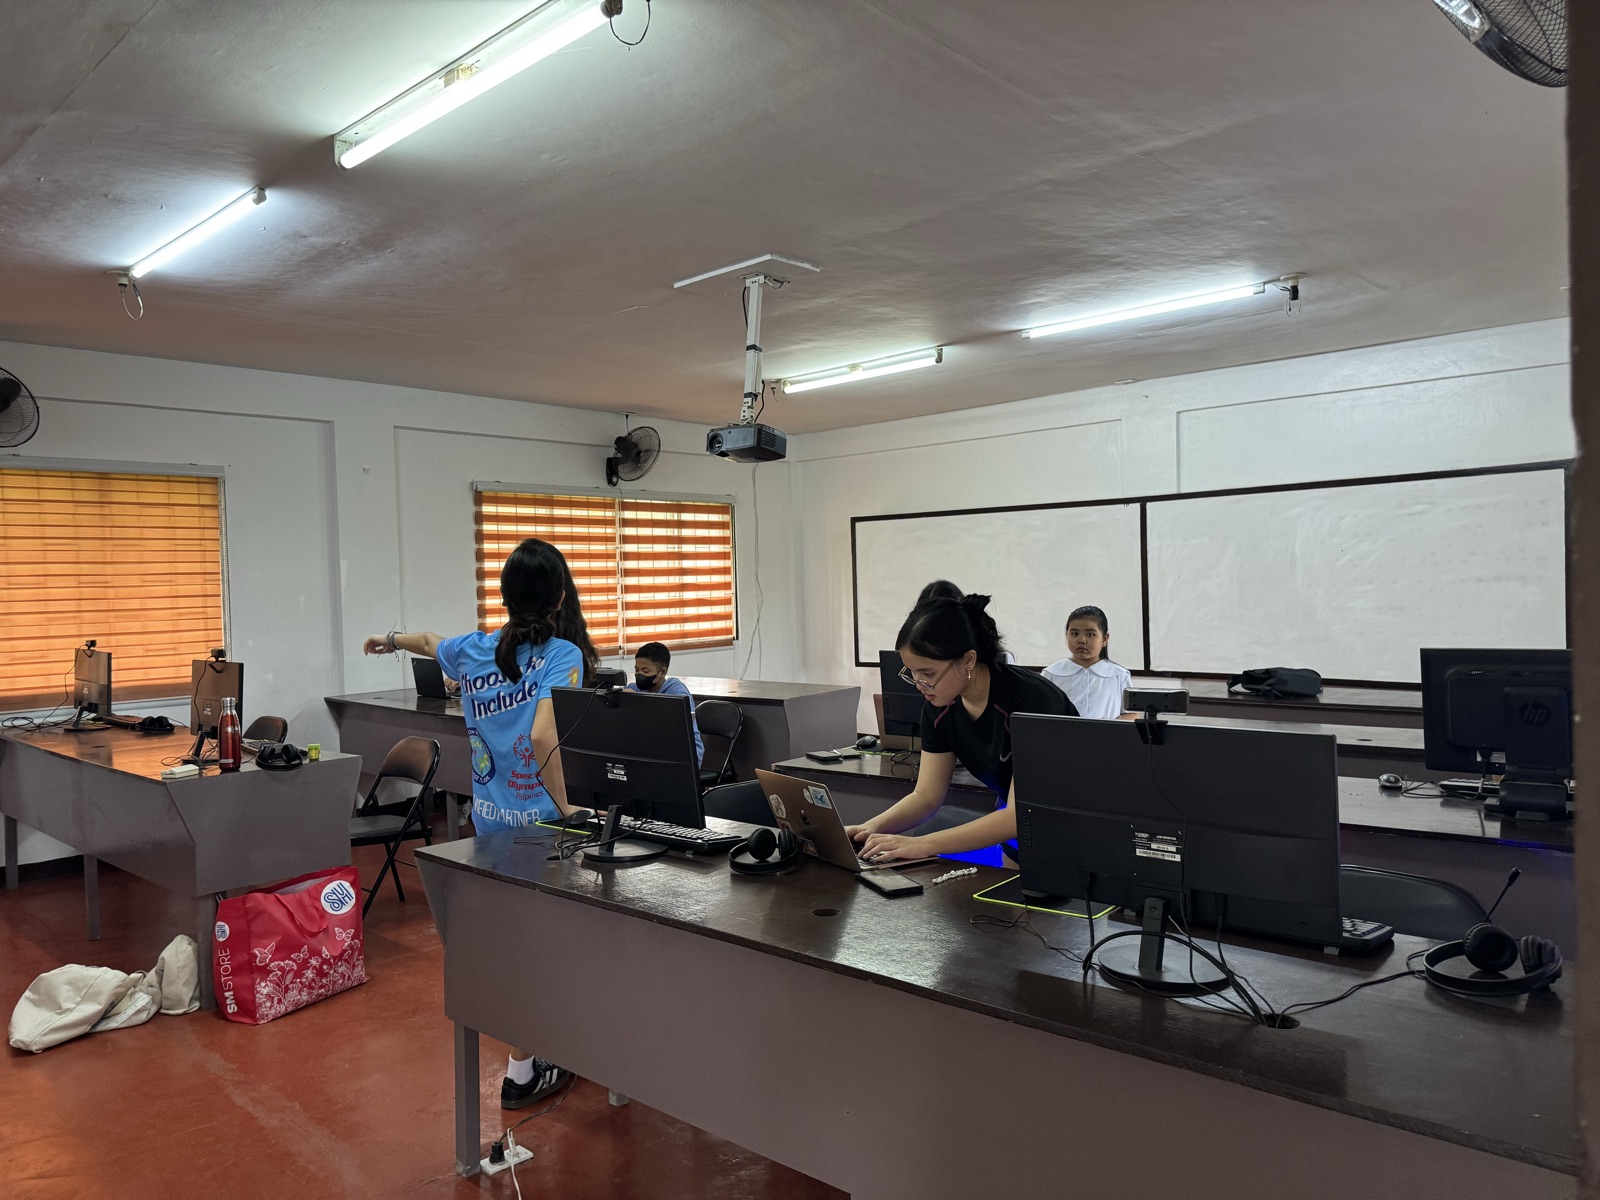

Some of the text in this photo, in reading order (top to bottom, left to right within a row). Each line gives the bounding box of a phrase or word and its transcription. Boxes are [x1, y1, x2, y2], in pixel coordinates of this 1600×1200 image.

[524, 656, 546, 675] to
[470, 680, 539, 720] Include
[1520, 701, 1548, 726] hp
[508, 780, 545, 791] Olympi
[511, 770, 542, 780] Spec
[218, 948, 238, 1014] SM STORE
